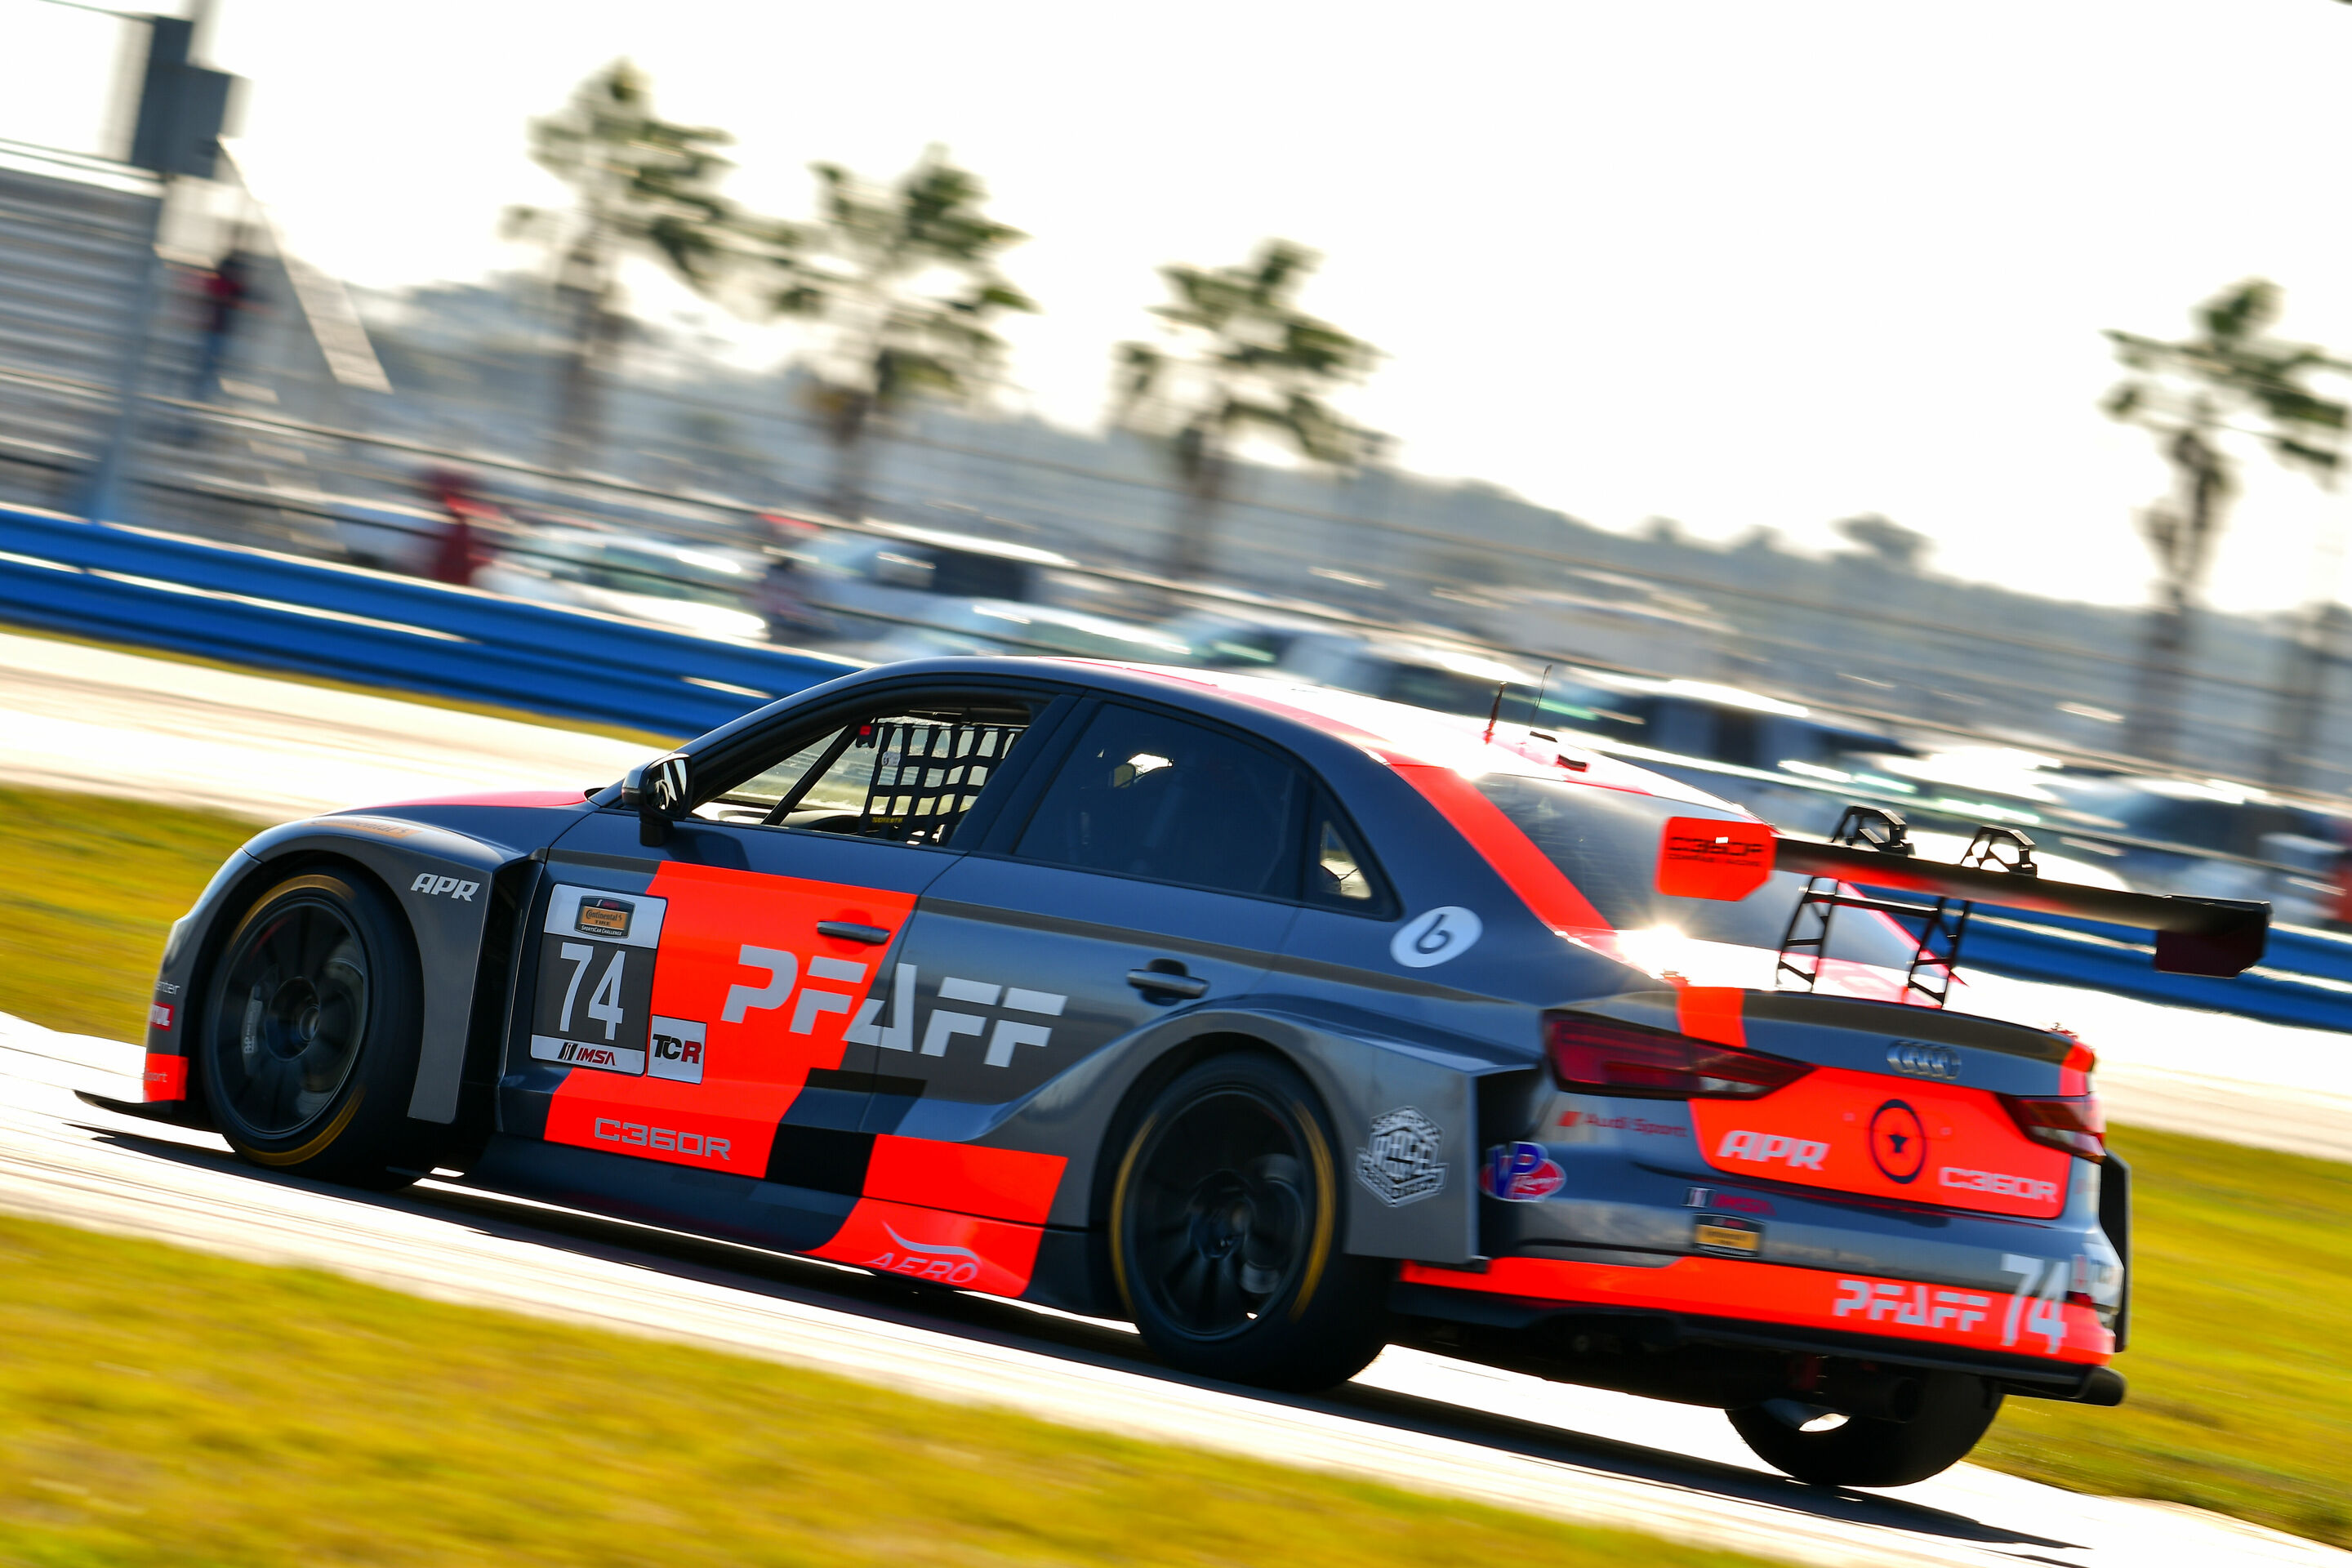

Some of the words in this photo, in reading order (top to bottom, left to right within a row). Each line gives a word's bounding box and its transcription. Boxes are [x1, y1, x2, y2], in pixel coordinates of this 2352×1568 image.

[410, 872, 480, 902] APR
[586, 909, 617, 921] Continental
[559, 942, 626, 1041] 74
[720, 944, 1067, 1067] PFAFF
[576, 1047, 617, 1067] IMSA
[653, 1034, 702, 1064] TCR
[595, 1117, 732, 1160] C360R
[1583, 1113, 1627, 1129] Audi
[1631, 1118, 1689, 1138] Sport
[1716, 1130, 1830, 1170] APR
[1487, 1142, 1548, 1199] VP
[1939, 1167, 2058, 1203] C360R
[863, 1252, 978, 1283] AERO
[1833, 1279, 1992, 1332] PFAFF
[2001, 1253, 2071, 1354] 74
